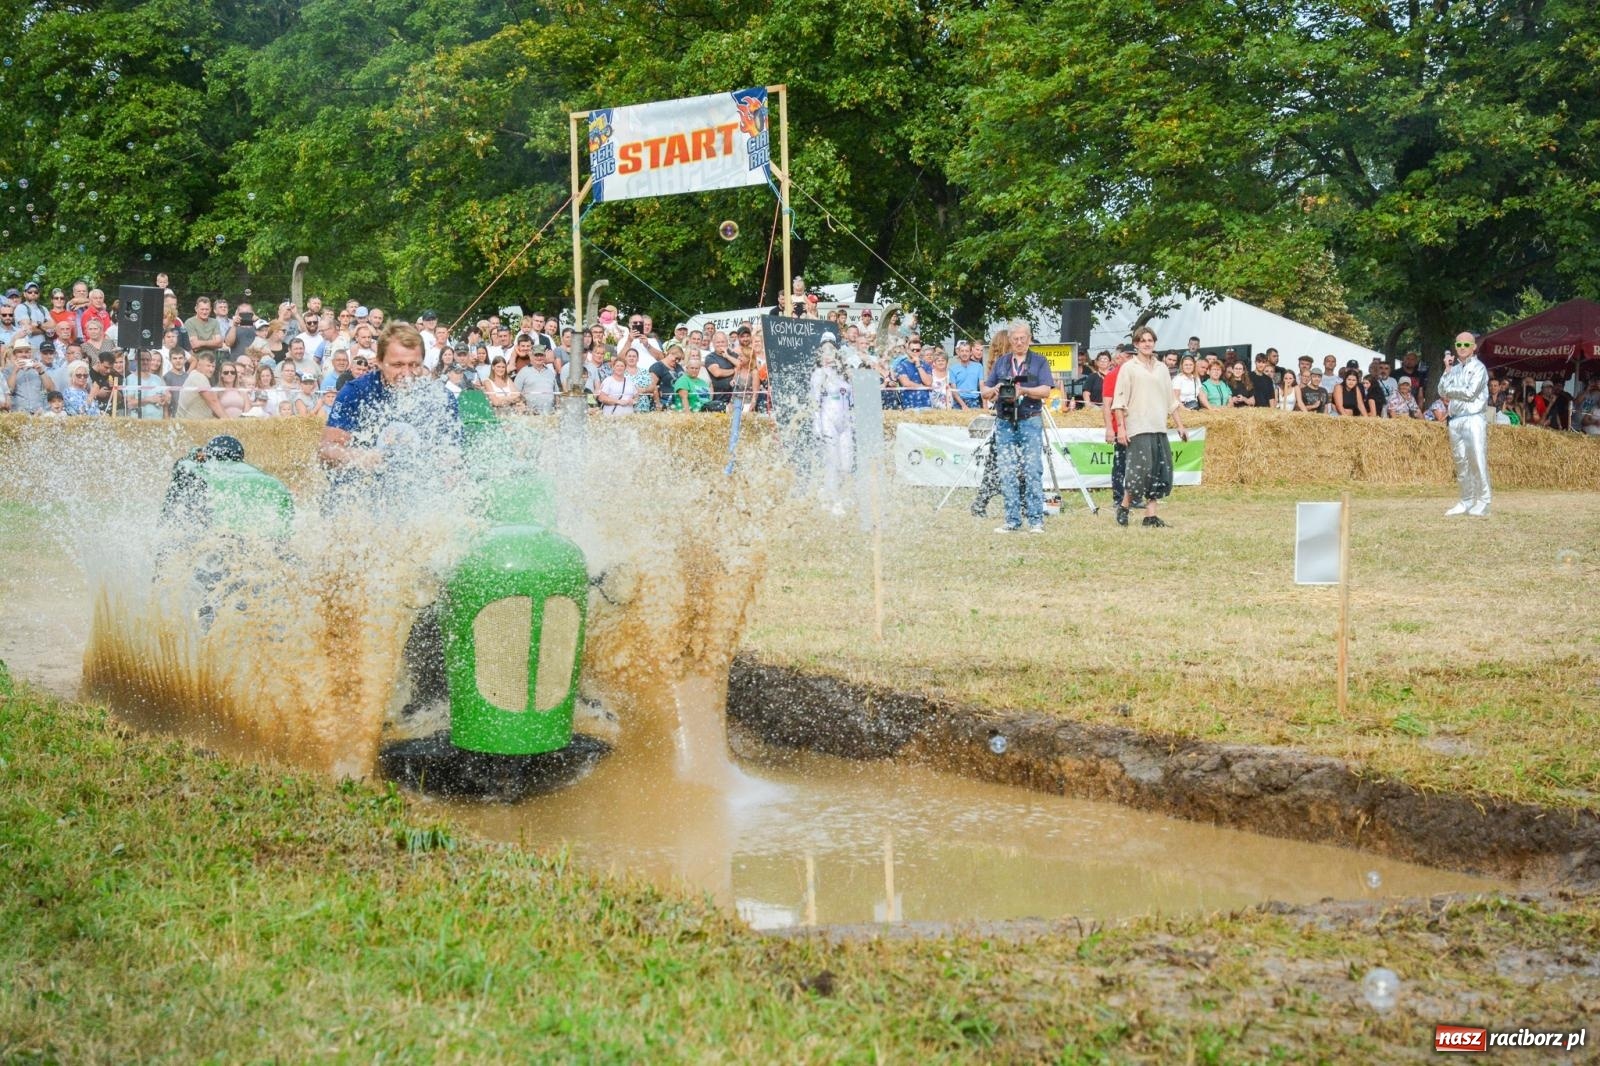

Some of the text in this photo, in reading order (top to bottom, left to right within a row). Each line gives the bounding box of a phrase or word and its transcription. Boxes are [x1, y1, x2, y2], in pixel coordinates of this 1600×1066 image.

[617, 122, 739, 175] START
[770, 320, 817, 336] KOSMICZNE
[778, 337, 804, 347] WYNIKI
[1493, 344, 1570, 357] RACIBORSKIE
